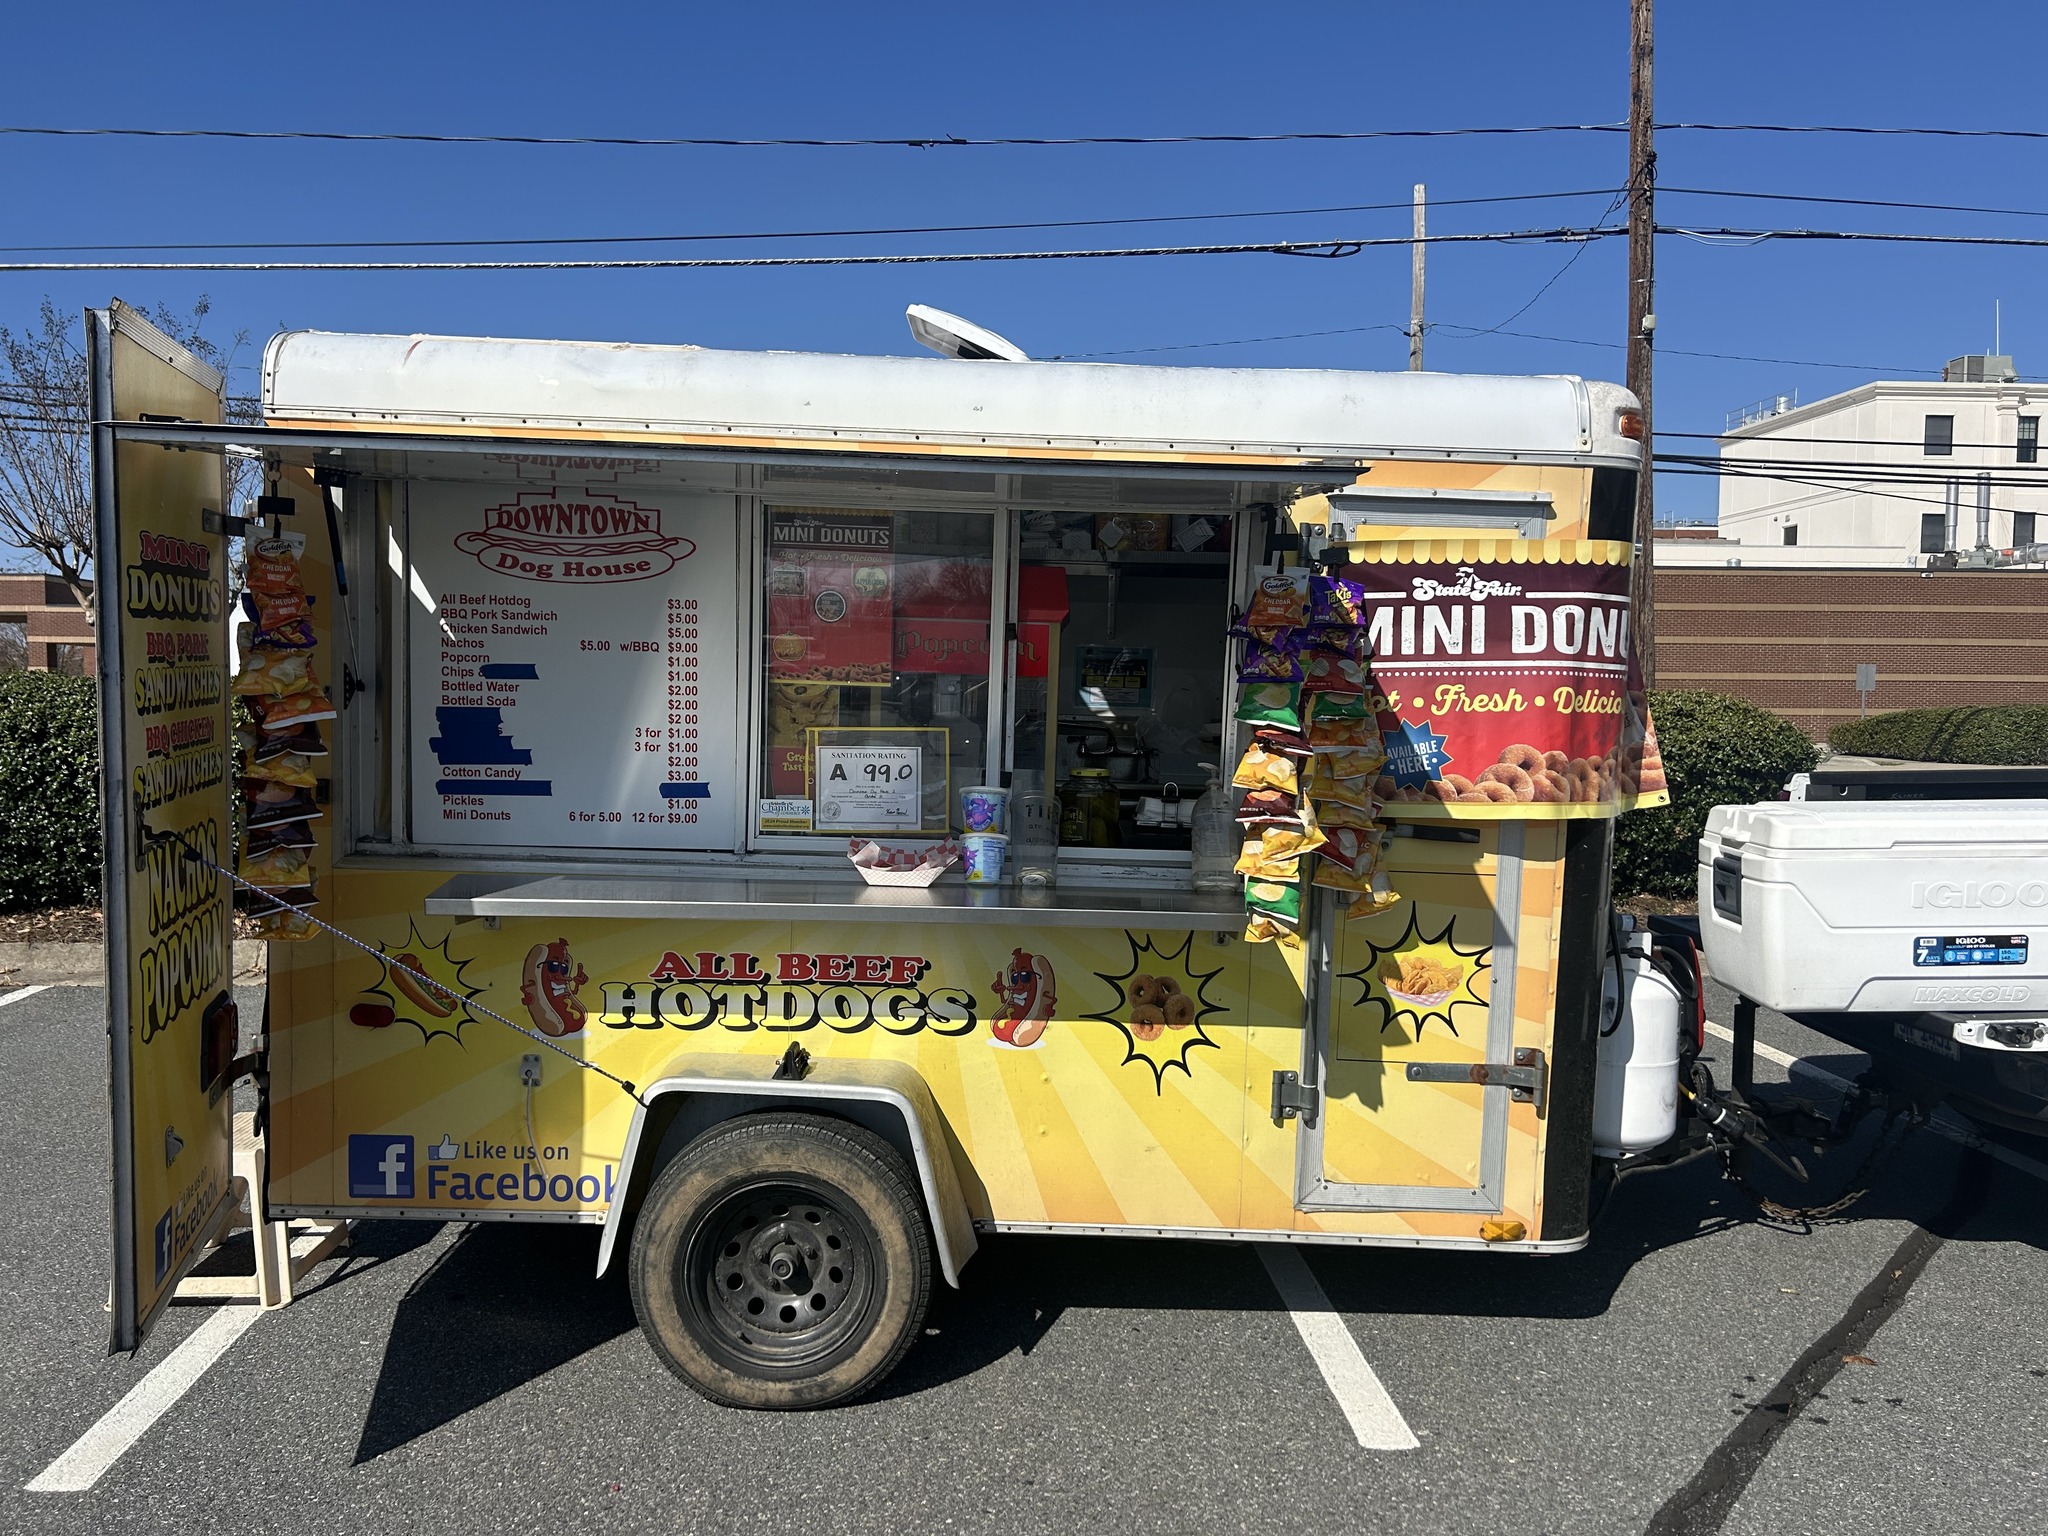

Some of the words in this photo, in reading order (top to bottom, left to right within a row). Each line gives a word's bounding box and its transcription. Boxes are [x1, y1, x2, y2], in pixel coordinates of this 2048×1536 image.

[496, 503, 651, 535] DOWNTOWN
[773, 526, 814, 542] MINI
[820, 528, 890, 545] DONUTS
[140, 531, 209, 572] MINI
[260, 542, 292, 553] Goldfish
[495, 553, 554, 578] Dog
[562, 559, 651, 577] House
[806, 551, 833, 561] Fresh
[840, 552, 883, 563] Delicious
[262, 563, 292, 572] CHEDDAR
[127, 566, 222, 623] DONUTS
[1412, 577, 1471, 601] State
[1470, 578, 1522, 602] Fair
[440, 594, 456, 605] All
[460, 594, 486, 605] Beef
[489, 594, 532, 608] Hotdog
[667, 598, 698, 610] $3.00
[1264, 597, 1291, 605] CHEDDAR
[441, 608, 468, 620] BBQ
[471, 609, 498, 620] Pork
[501, 609, 558, 621] Sandwich
[667, 613, 698, 625] $5.00
[441, 623, 488, 634] Chicken
[491, 623, 548, 635] Sandwich
[667, 627, 698, 639] $5.00
[146, 631, 175, 666] BBQ
[176, 632, 210, 662] PORK
[441, 637, 485, 649] Nachos
[580, 639, 610, 652] $5.00
[619, 641, 660, 653] w/BBQ
[667, 642, 698, 654] $9.00
[896, 630, 1041, 661] Popcon
[441, 651, 490, 664] Popcorn
[667, 656, 698, 668] $1.00
[441, 666, 474, 679] Chips
[667, 670, 698, 682] $1.00
[134, 665, 220, 715] SANDWICHES
[441, 680, 483, 692] Bottled
[486, 681, 520, 693] Water
[667, 685, 698, 697] $2.00
[442, 695, 483, 706] Bottled
[486, 695, 516, 707] Soda
[667, 699, 698, 711] $2.00
[1369, 689, 1403, 713] ot
[1430, 684, 1528, 716] Fresh
[145, 724, 170, 757] BBQ
[170, 715, 215, 749] CHICKEN
[635, 727, 642, 738] 3
[645, 727, 661, 738] for
[667, 728, 698, 740] $1.00
[634, 742, 641, 752] 3
[644, 742, 661, 752] for
[667, 742, 698, 754] $1.00
[786, 752, 815, 762] Gret
[1386, 740, 1439, 760] AVAILABLE
[667, 756, 698, 768] $2.00
[1397, 754, 1432, 775] HERE
[133, 744, 223, 812] SANDWICHES
[442, 766, 481, 777] Cotton
[484, 767, 521, 780] Candy
[667, 770, 698, 782] $3.00
[829, 763, 848, 781] A
[863, 764, 913, 783] 99.0
[443, 795, 484, 806] Pickles
[667, 799, 698, 810] $1.00
[761, 801, 801, 812] Chamber
[443, 809, 467, 820] Mini
[470, 810, 511, 821] Donuts
[569, 811, 576, 822] 6
[578, 811, 595, 822] for
[598, 812, 622, 823] 5.00
[632, 812, 645, 823] 12
[648, 812, 665, 823] for
[667, 813, 698, 825] $9.00
[147, 818, 219, 938] NACHOS
[1911, 880, 2048, 909] IGLOO
[1955, 937, 1986, 945] IGLOO
[1917, 949, 1929, 962] 7
[140, 898, 224, 1044] POPCORN
[649, 951, 768, 983] ALL
[776, 953, 931, 987] BEEF
[1913, 986, 2031, 1003] MAXCOLD
[599, 981, 978, 1036] HOTDOGS
[464, 1140, 506, 1160] Like
[513, 1144, 536, 1160] us
[543, 1144, 569, 1160] on
[428, 1163, 617, 1203] Facebook
[175, 1168, 219, 1261] Facebook
